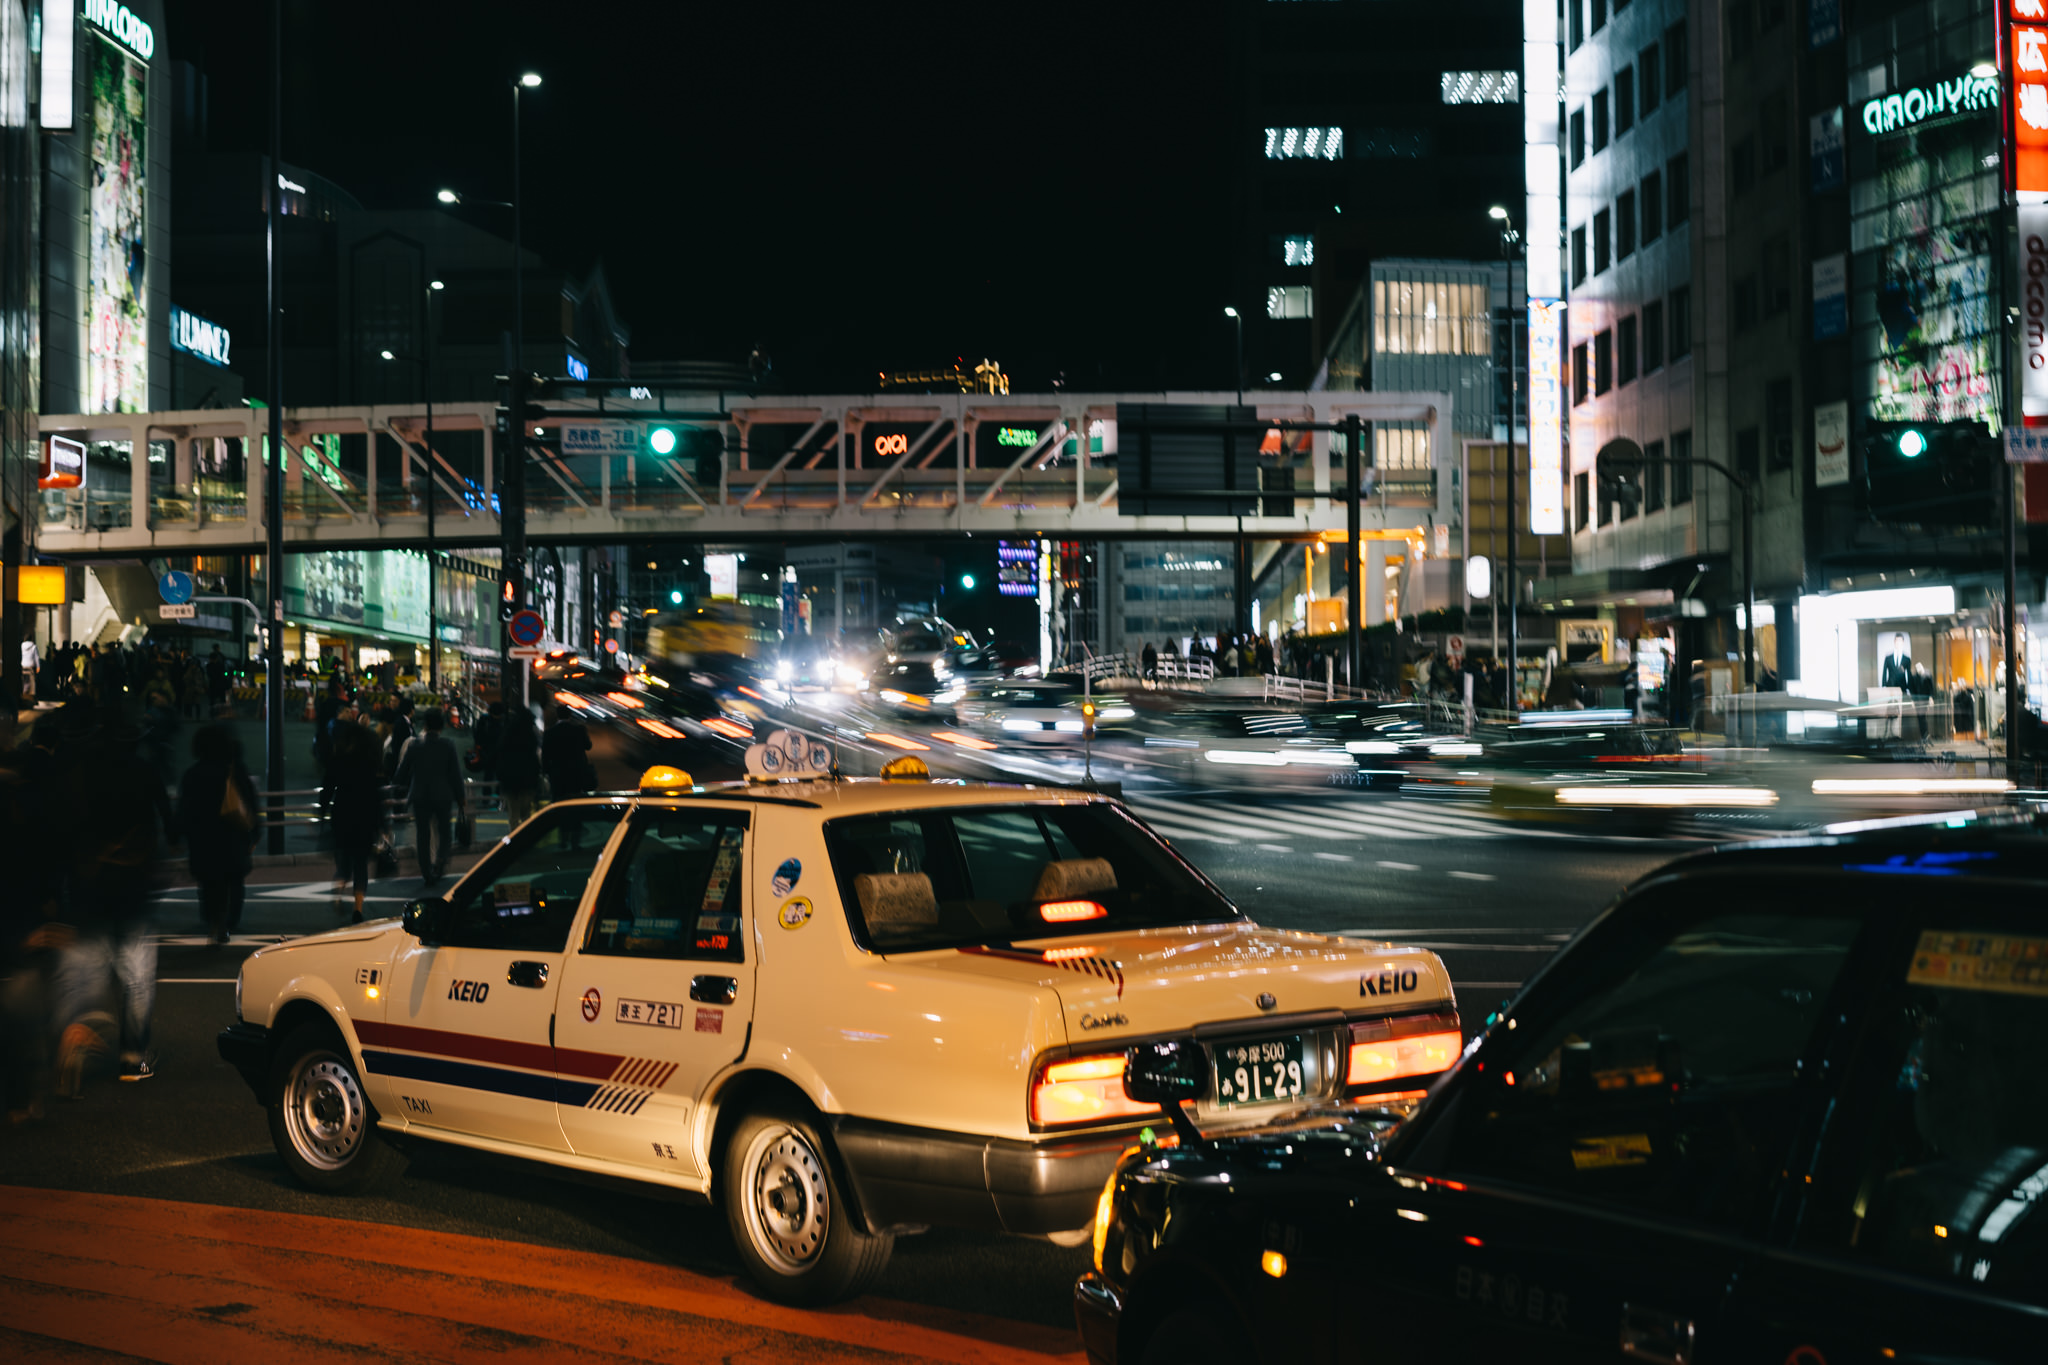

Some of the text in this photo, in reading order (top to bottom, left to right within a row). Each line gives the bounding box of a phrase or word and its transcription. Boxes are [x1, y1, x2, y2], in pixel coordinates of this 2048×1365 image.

[448, 979, 490, 1003] KEIO
[1360, 969, 1417, 997] KEIO
[620, 1002, 641, 1020] 京王
[647, 1002, 676, 1026] 721
[1262, 1042, 1285, 1062] 500
[1235, 1060, 1302, 1102] 91-29
[401, 1096, 432, 1115] TAXI
[651, 1142, 678, 1160] 京王
